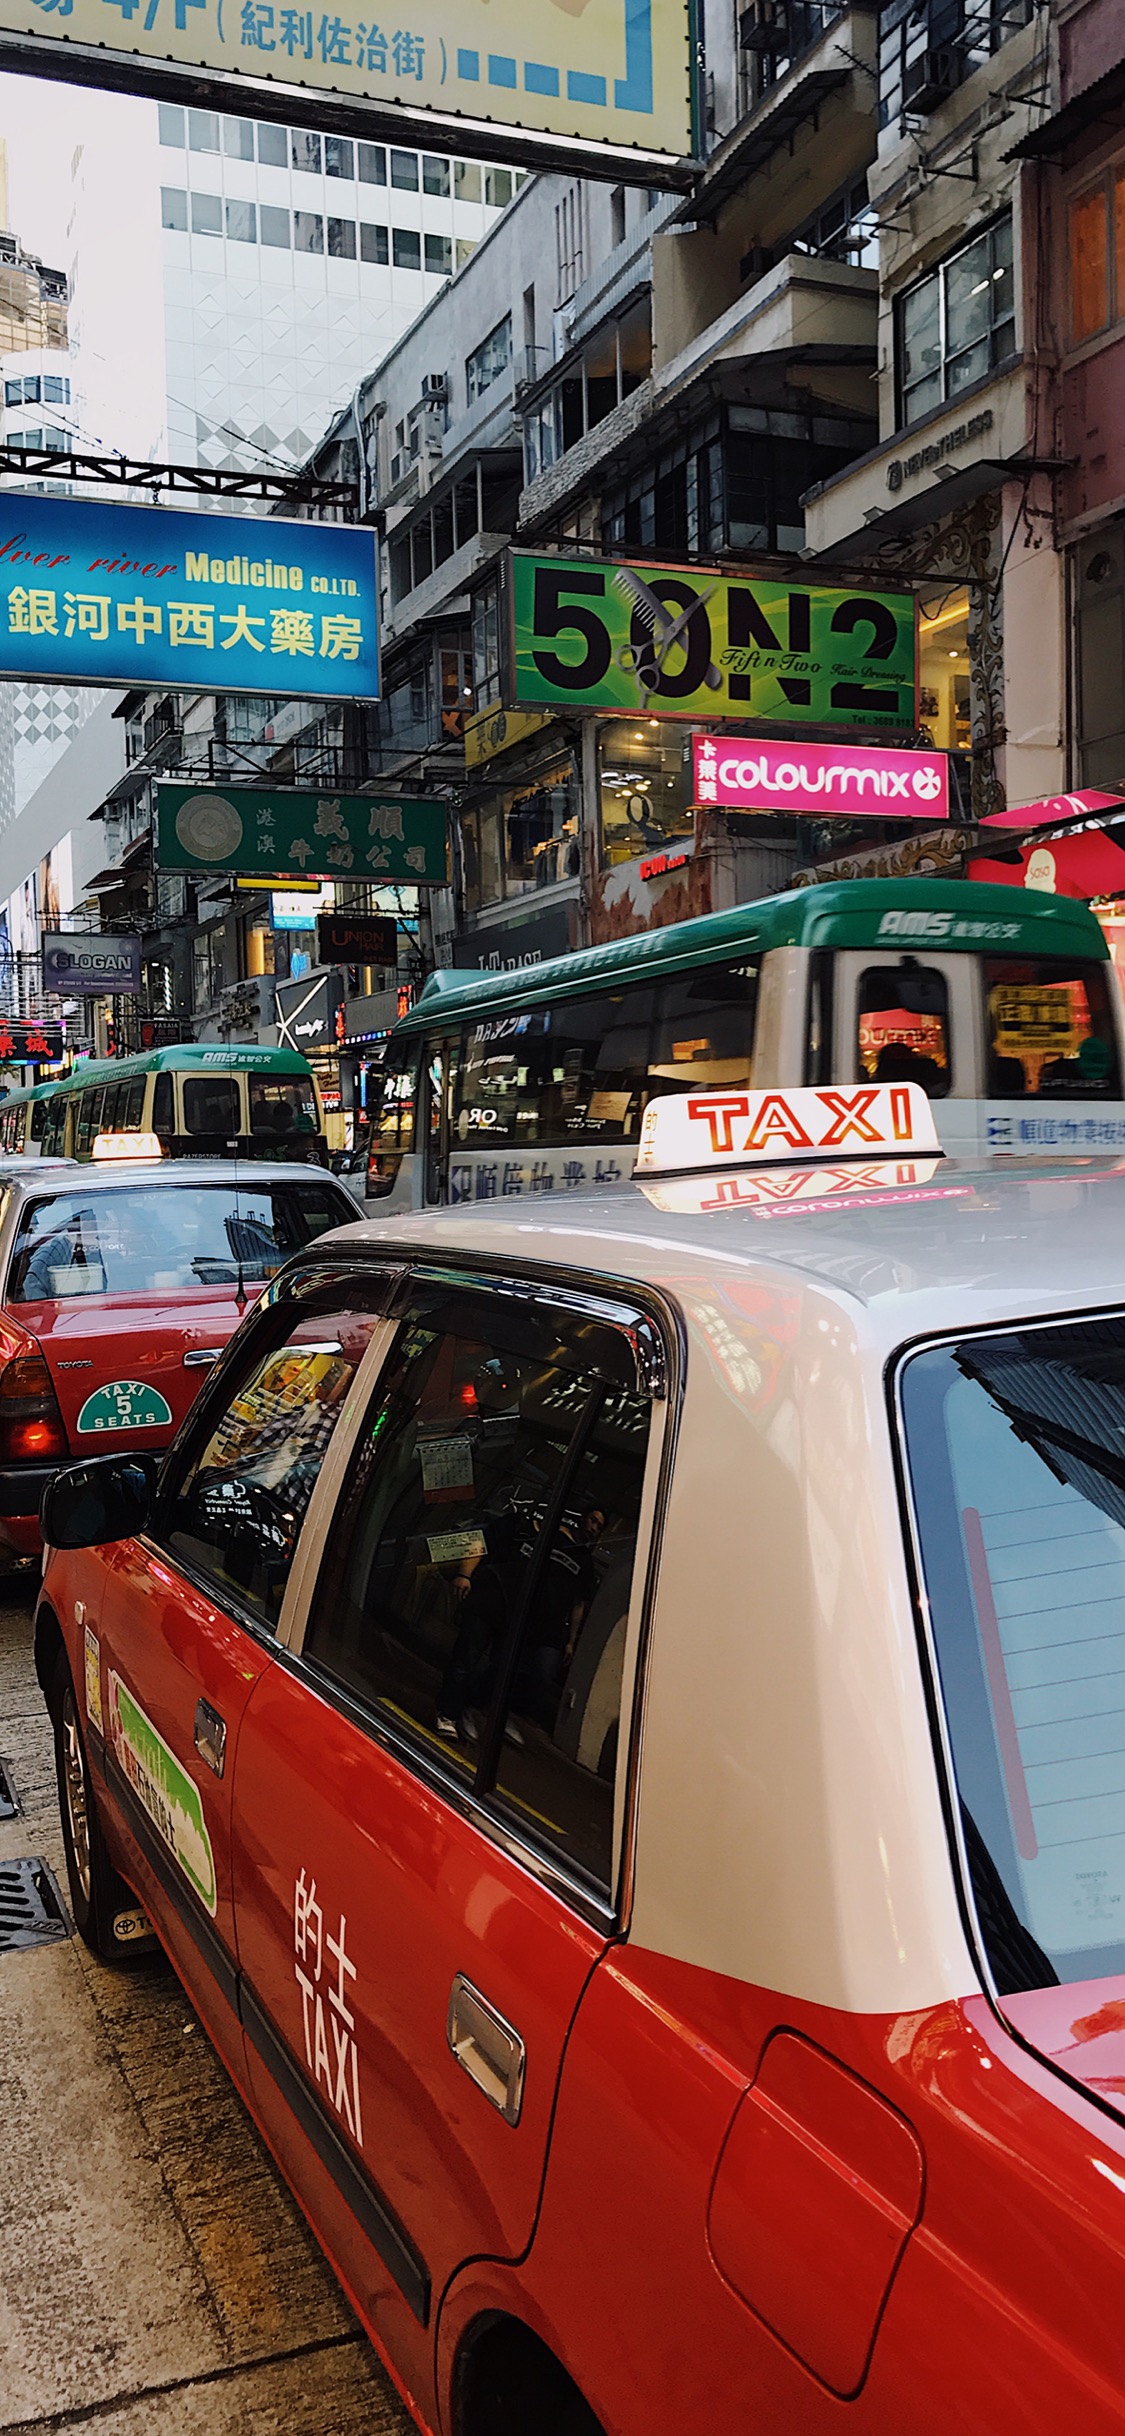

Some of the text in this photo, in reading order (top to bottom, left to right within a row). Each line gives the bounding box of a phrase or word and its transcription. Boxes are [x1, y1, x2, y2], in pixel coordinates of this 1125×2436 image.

[86, 552, 178, 578] river
[185, 551, 303, 591] Medicine
[7, 586, 364, 660] 銀河中西大藥房
[779, 653, 823, 673] Two
[314, 799, 404, 841] 義順
[288, 838, 426, 873] 牛奶公司
[877, 911, 955, 936] AMS
[332, 930, 385, 945] UNION
[57, 952, 132, 970] SLOGAN
[202, 1052, 238, 1063] AMS
[688, 1088, 914, 1152] TAXI
[101, 1138, 154, 1152] TAXI
[57, 1360, 94, 1368] TOYOTA
[101, 1384, 146, 1399] TAXI
[116, 1395, 132, 1415] 5
[95, 1413, 155, 1428] SEATS
[295, 1867, 357, 2032] 的士
[295, 1962, 363, 2148] TAXI
